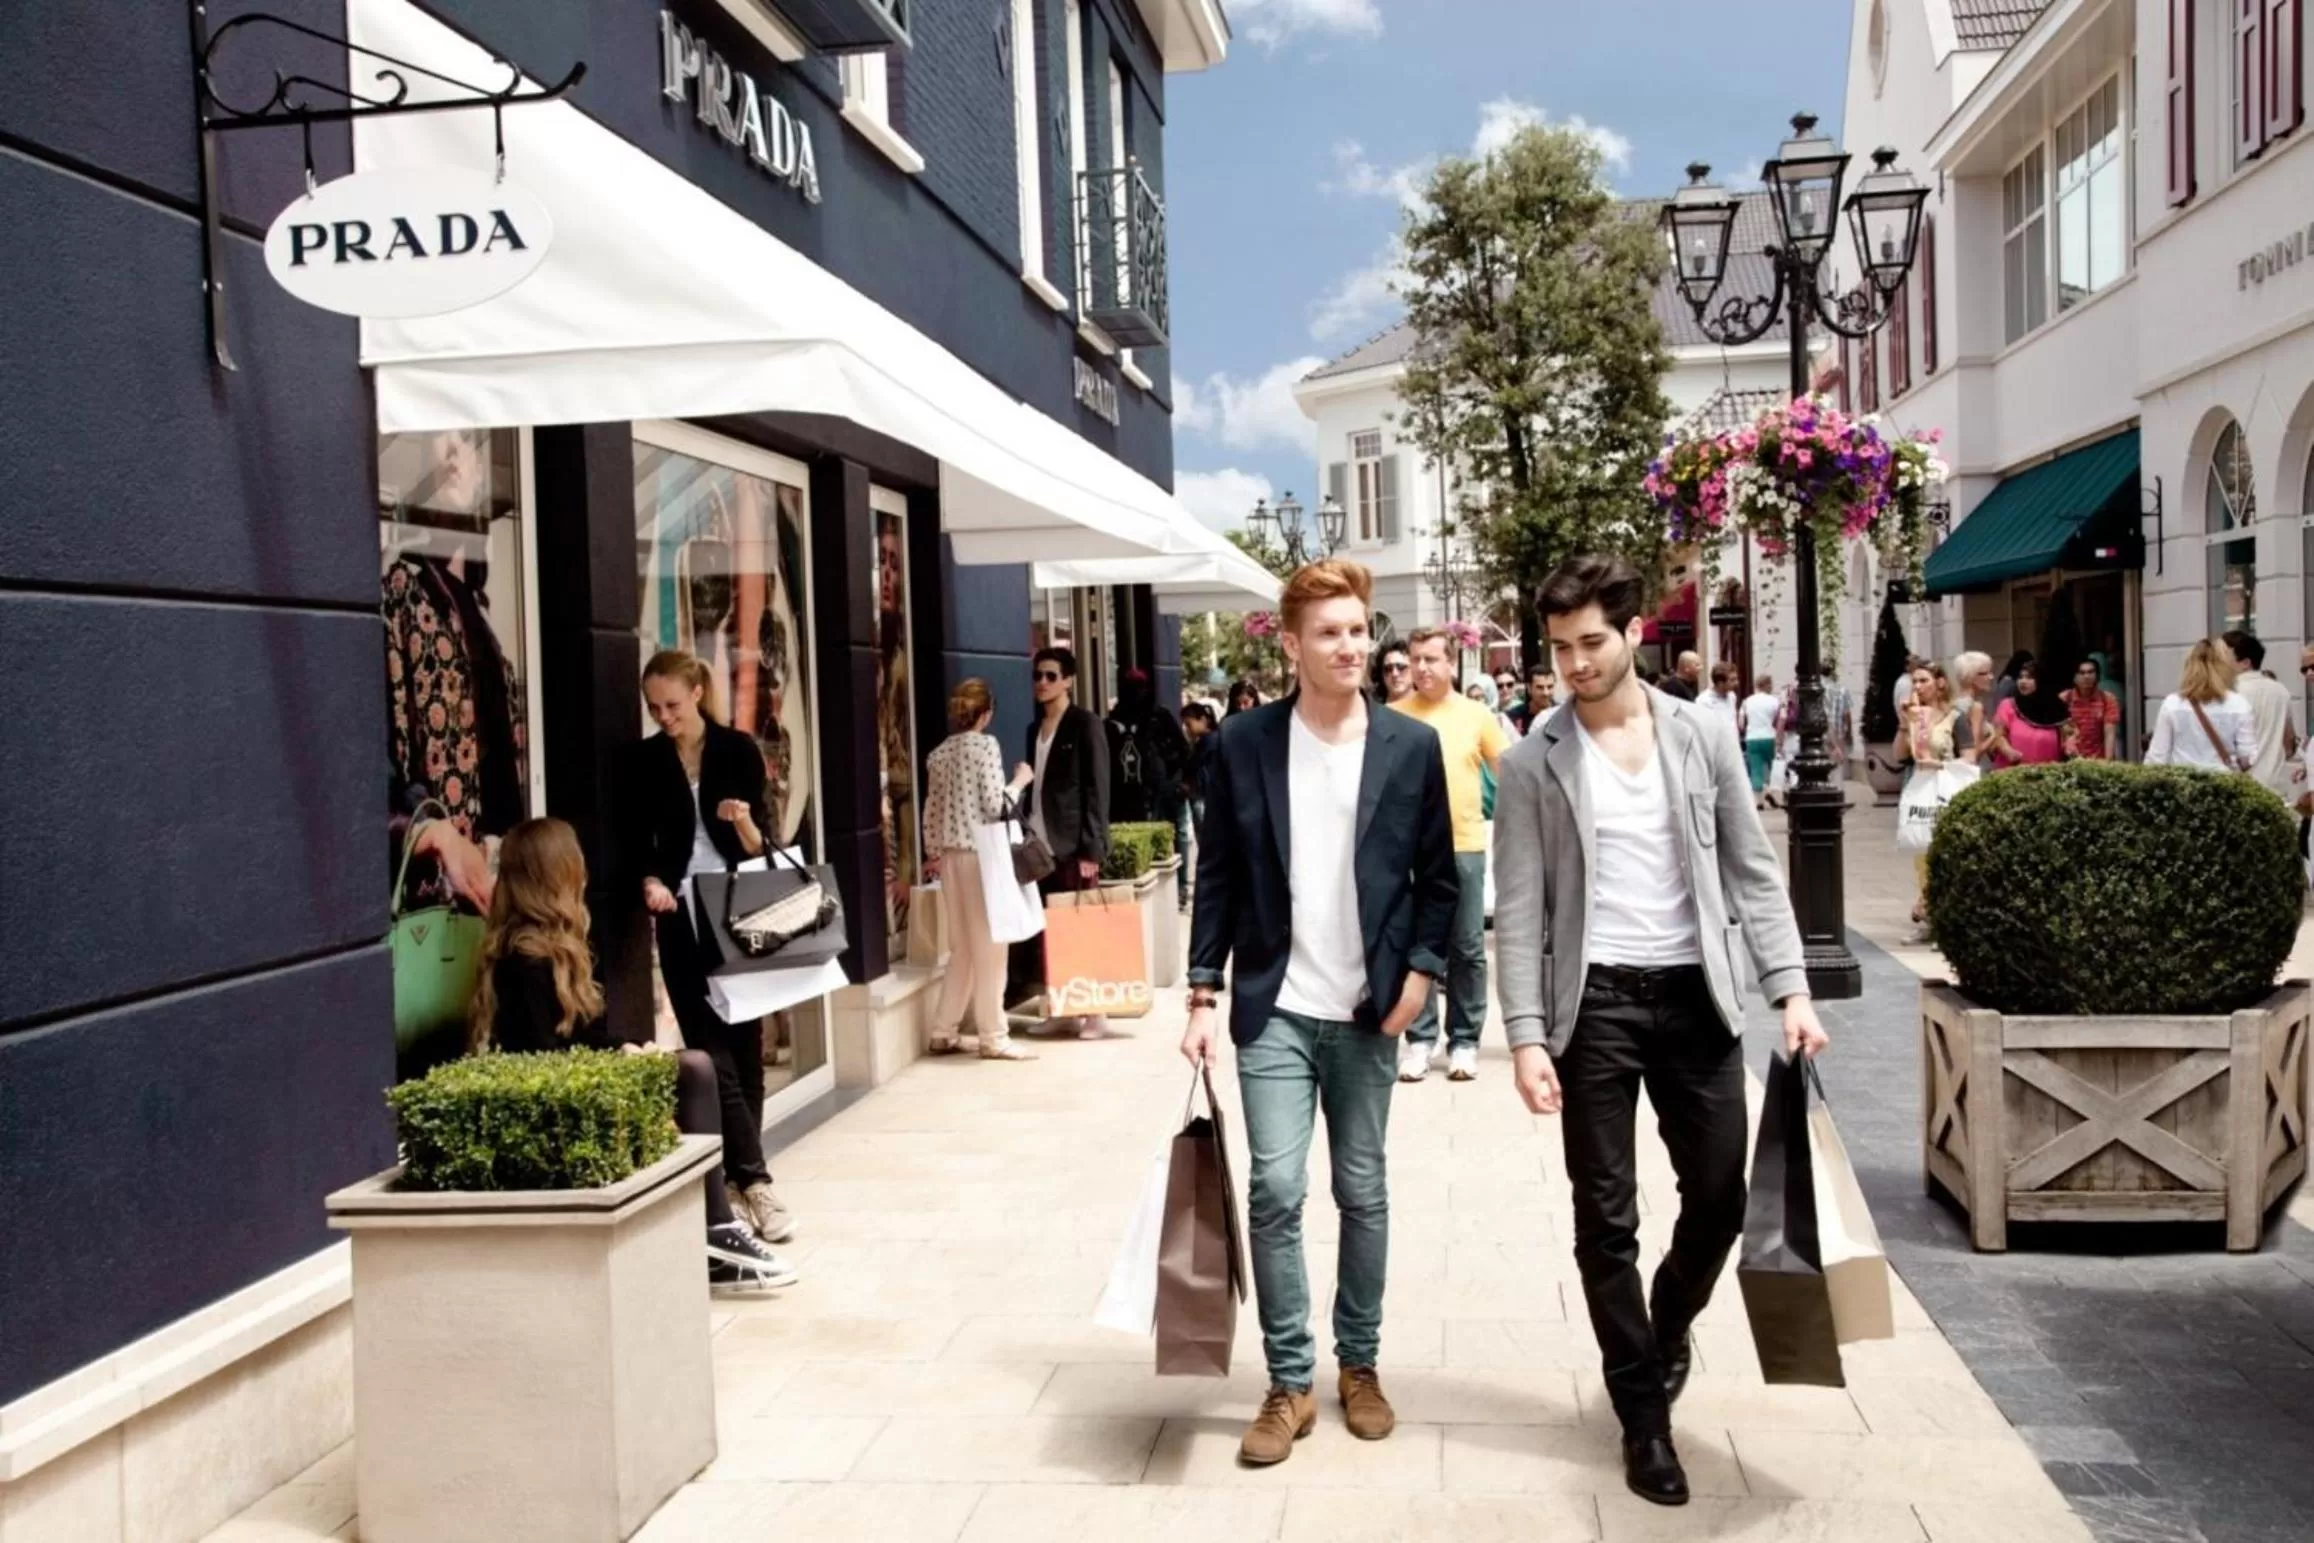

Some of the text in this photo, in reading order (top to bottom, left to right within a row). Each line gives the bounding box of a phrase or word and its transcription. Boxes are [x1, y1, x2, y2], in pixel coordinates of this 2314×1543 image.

[660, 9, 822, 204] PRADA
[288, 209, 528, 266] PRADA
[1048, 976, 1149, 1017] yStore
